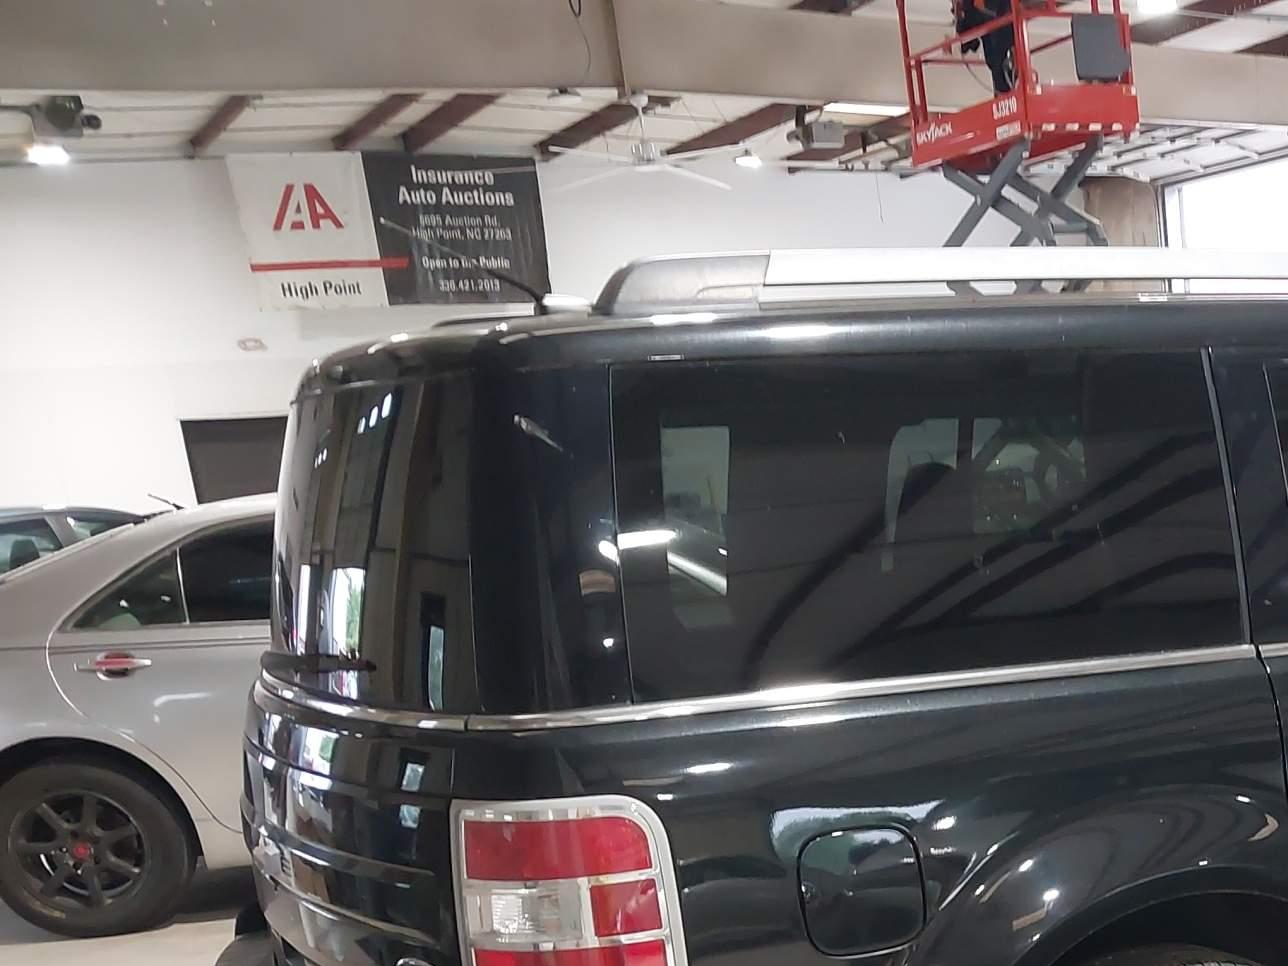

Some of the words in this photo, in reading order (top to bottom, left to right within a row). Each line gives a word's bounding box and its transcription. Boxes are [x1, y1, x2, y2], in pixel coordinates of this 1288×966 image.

[410, 164, 495, 186] Insurance
[398, 185, 437, 205] Auto
[441, 186, 515, 207] Auctions
[445, 214, 482, 228] Auction
[412, 226, 435, 241] High
[466, 227, 482, 240] NC
[422, 255, 448, 271] Open
[449, 256, 460, 269] to
[479, 255, 511, 270] Public
[281, 281, 319, 301] High
[322, 279, 363, 297] Point
